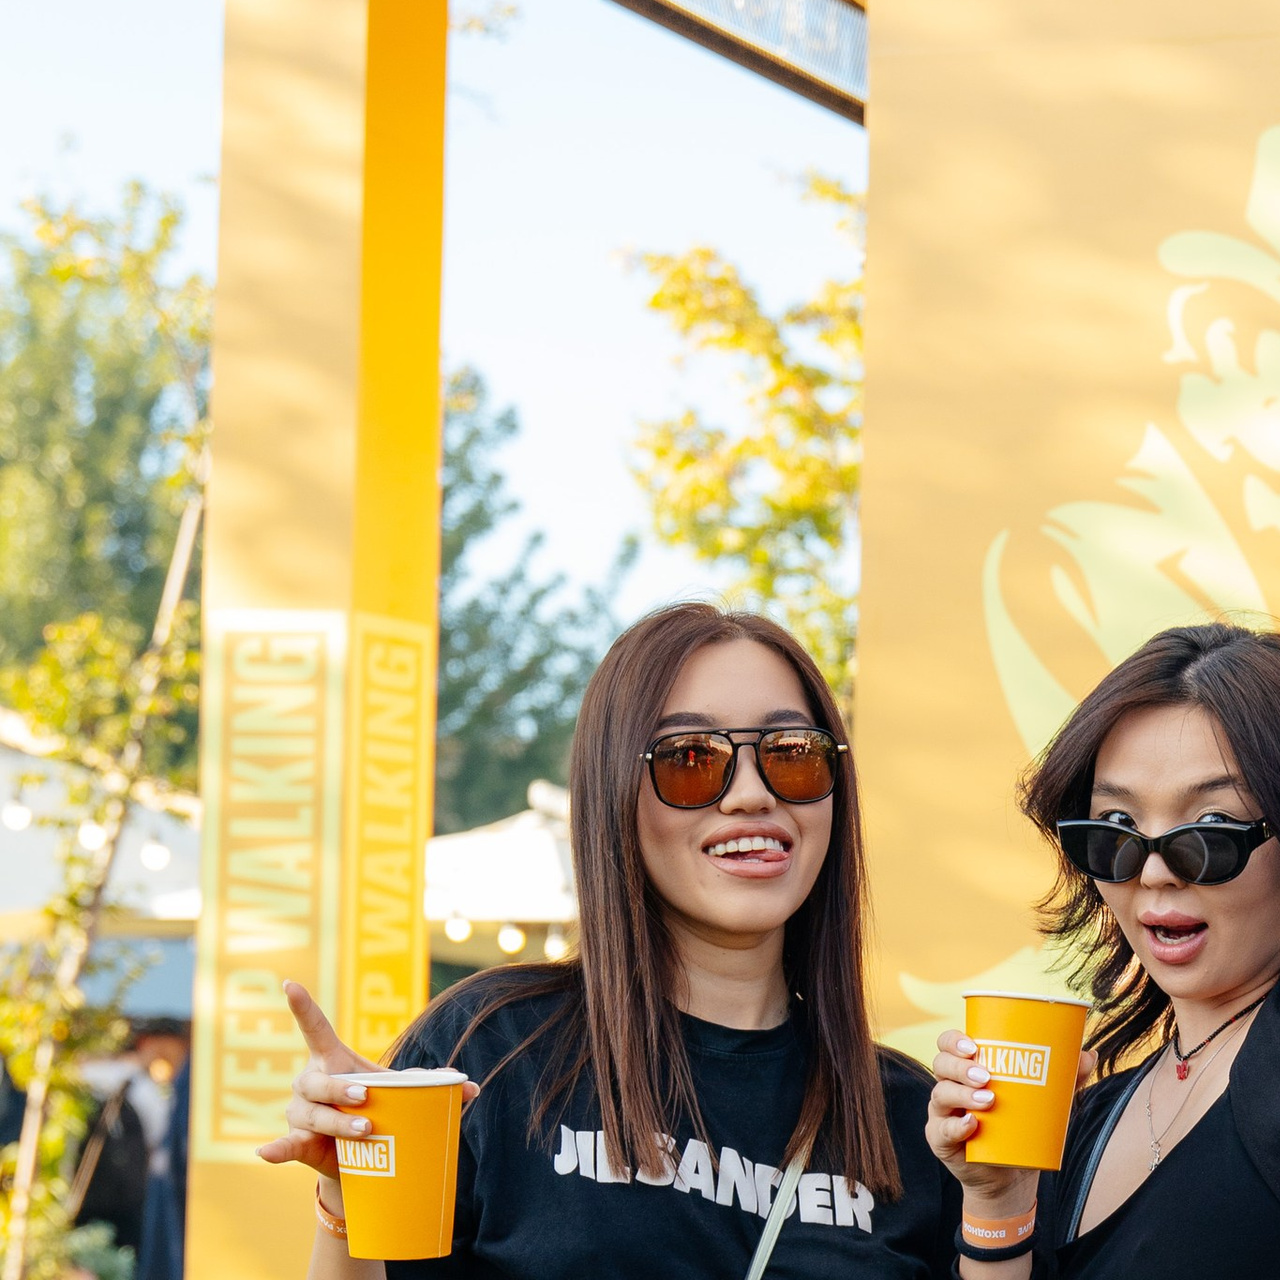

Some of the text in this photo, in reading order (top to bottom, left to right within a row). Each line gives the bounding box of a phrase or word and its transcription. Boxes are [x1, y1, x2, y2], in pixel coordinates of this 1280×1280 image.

[221, 637, 319, 1137] KEEP WALKING
[357, 640, 419, 1052] EP WALKING
[553, 1124, 631, 1184] JIL
[975, 1047, 1043, 1078] ALKING
